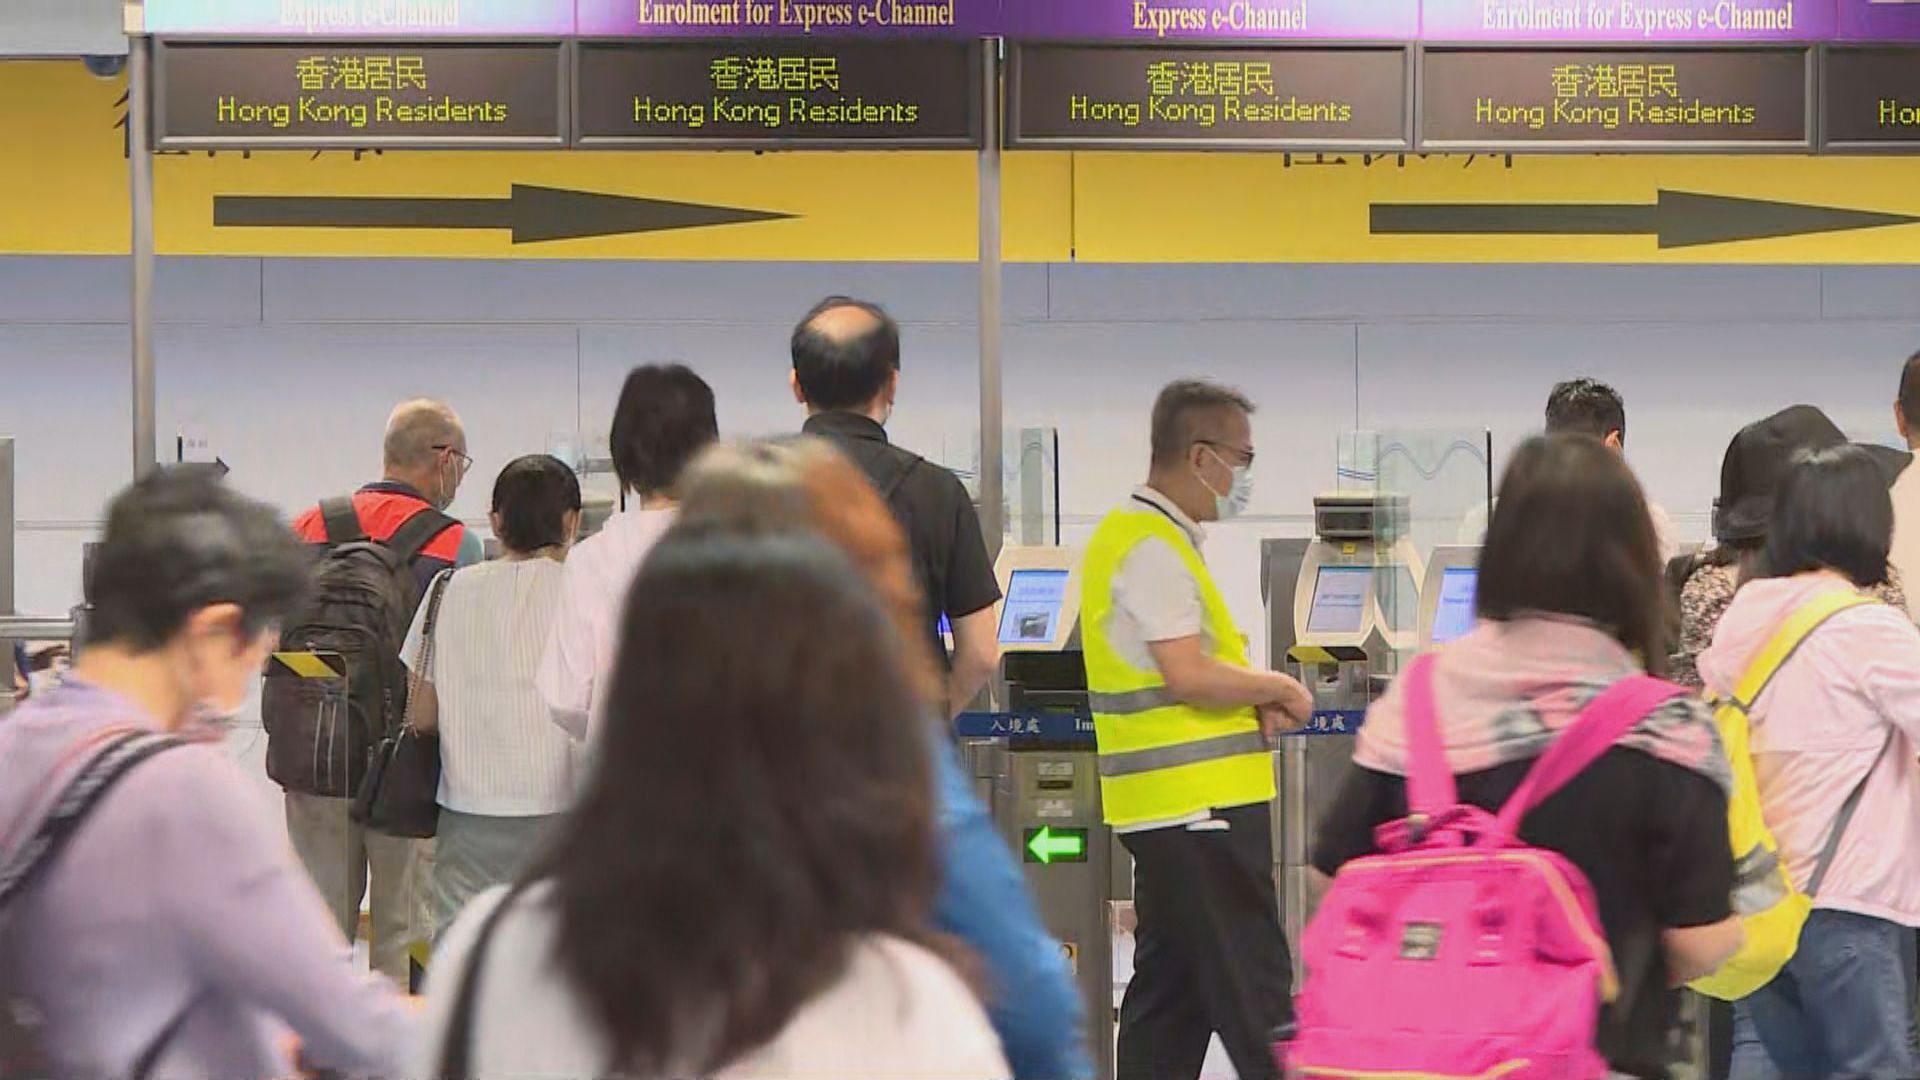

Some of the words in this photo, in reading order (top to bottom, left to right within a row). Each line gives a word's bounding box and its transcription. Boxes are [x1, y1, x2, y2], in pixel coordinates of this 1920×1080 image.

[281, 0, 355, 33] Express
[639, 0, 739, 25] Enrolment
[746, 0, 772, 25] for
[779, 0, 852, 33] Express
[858, 0, 955, 25] e-Channel
[1133, 0, 1206, 37] Express
[1212, 0, 1308, 30] e-Channel
[1483, 0, 1581, 29] Enrolment
[1588, 0, 1613, 29] for
[1620, 0, 1692, 36] Express
[1697, 0, 1793, 29] e-Channel
[296, 56, 427, 90] 香港居民
[710, 57, 840, 91] 香港居民
[1147, 61, 1274, 96] 香港居民
[1551, 64, 1679, 98] 香港居民
[217, 96, 290, 127] Hong
[299, 96, 367, 127] Kong
[375, 96, 508, 122] Residents
[633, 97, 704, 128] Hong
[712, 97, 780, 127] Kong
[789, 97, 918, 122] Residents
[1071, 95, 1140, 126] Hong
[1150, 95, 1215, 126] Kong
[1224, 96, 1351, 122] Residents
[1475, 98, 1545, 129] Hong
[1553, 98, 1619, 129] Kong
[1628, 98, 1756, 124] Residents
[1075, 718, 1094, 731] Im
